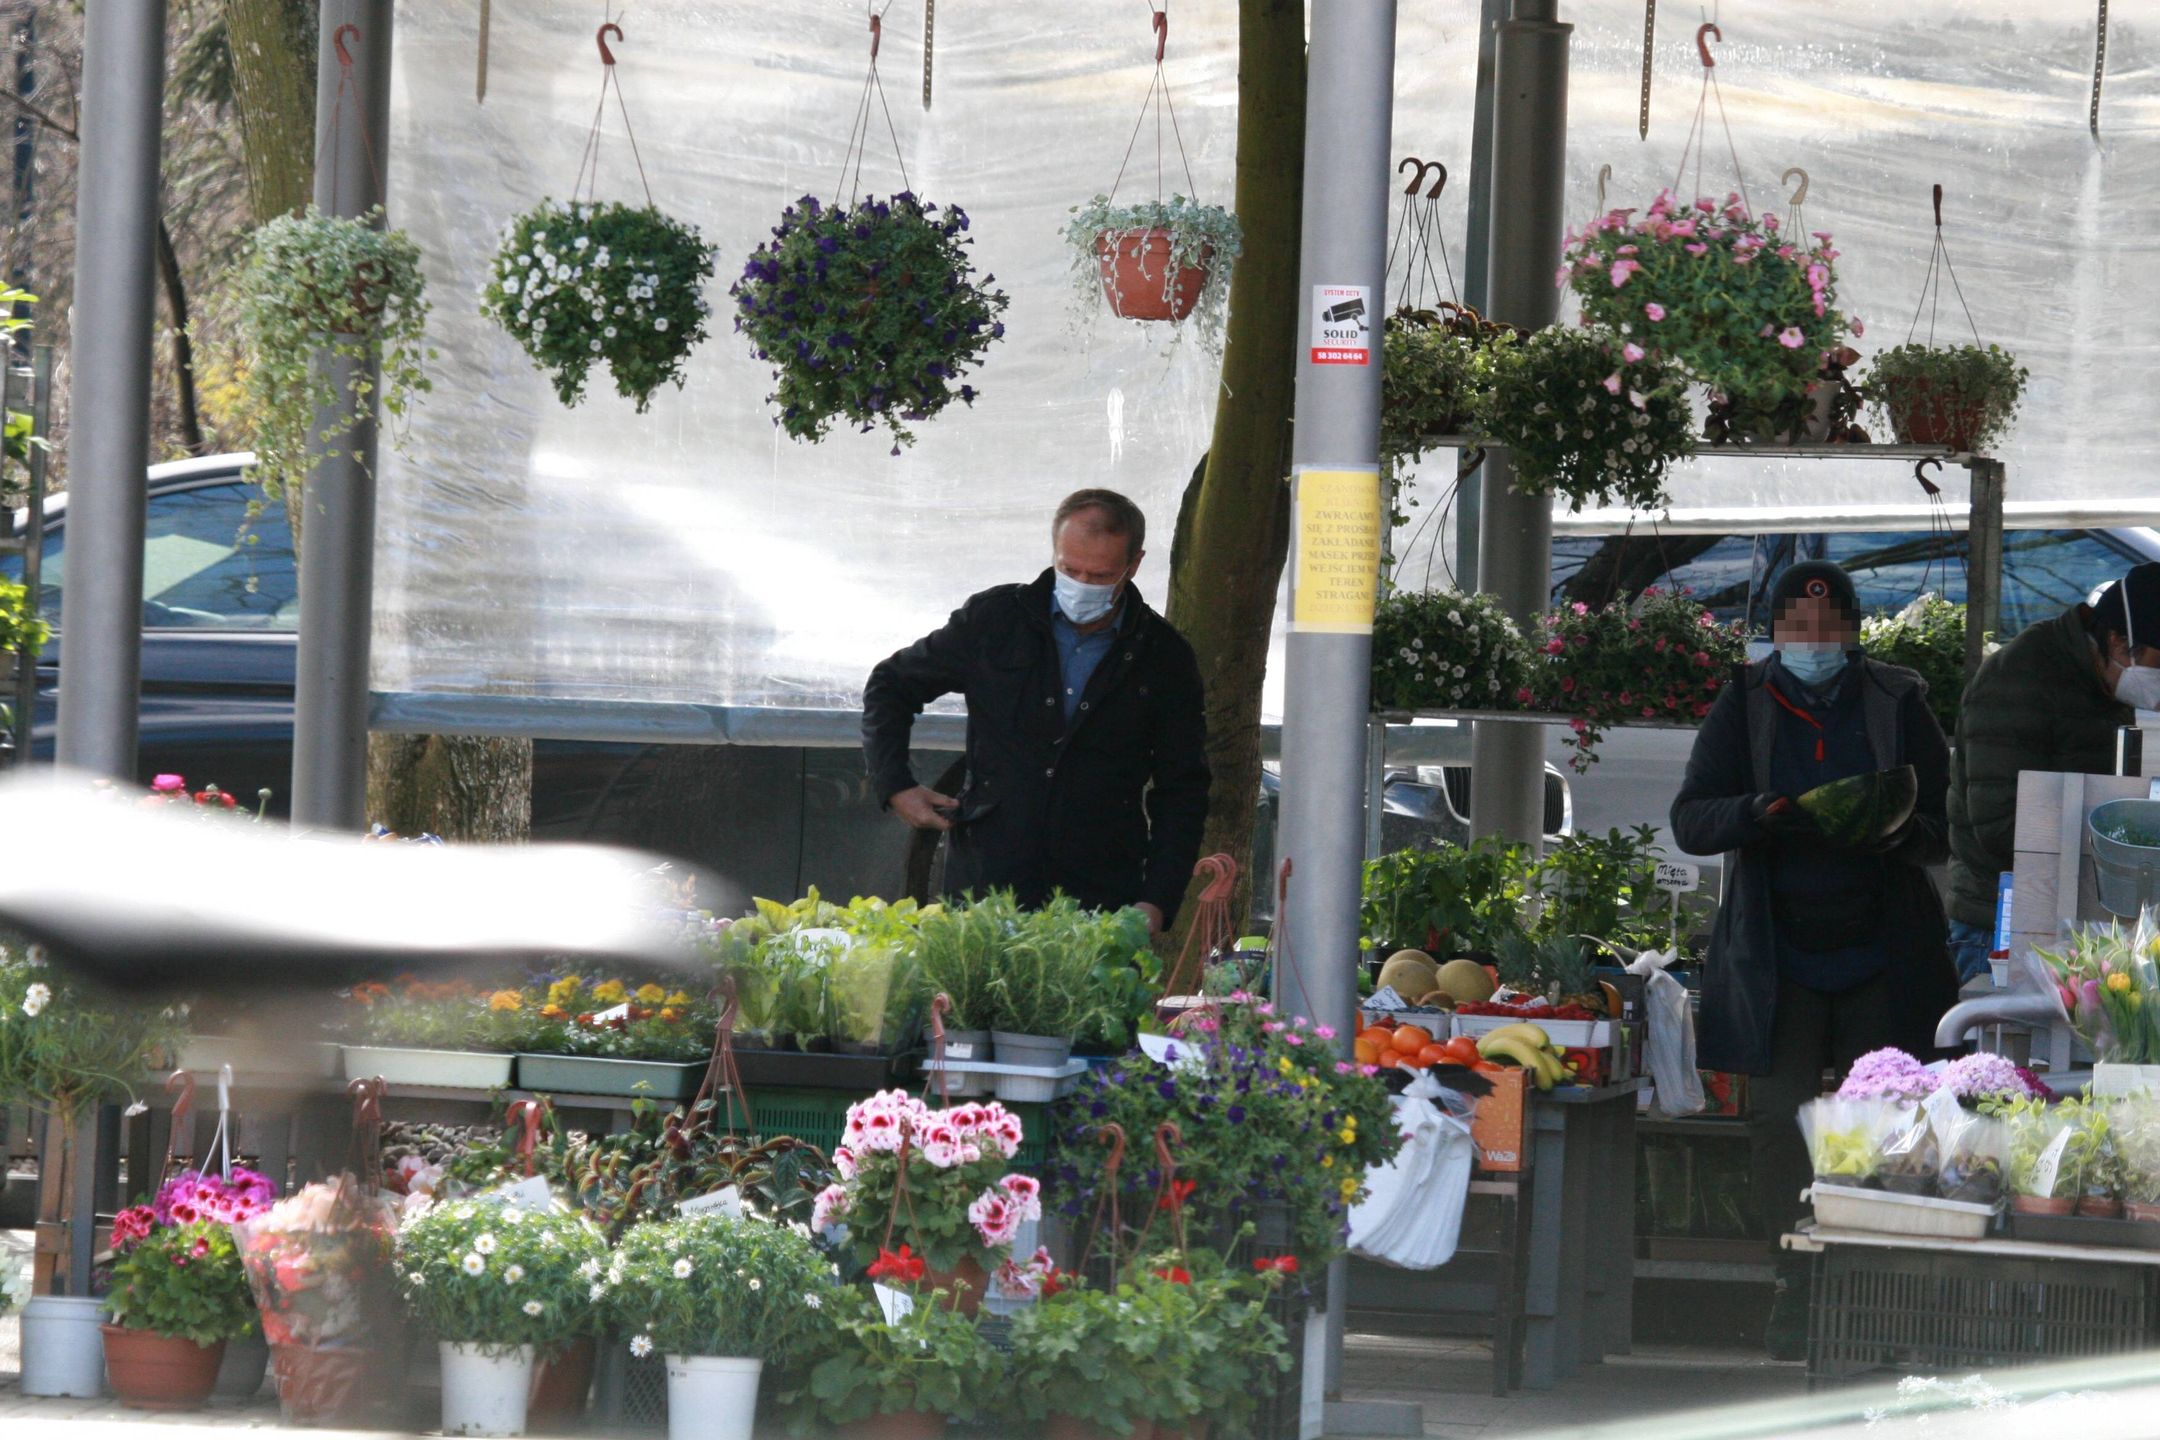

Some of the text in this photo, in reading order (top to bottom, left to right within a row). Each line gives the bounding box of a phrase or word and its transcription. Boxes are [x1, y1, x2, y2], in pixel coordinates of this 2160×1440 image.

[1323, 329, 1358, 339] SOLID
[1326, 524, 1334, 534] Z
[1308, 551, 1349, 560] MASEK
[1329, 577, 1365, 587] TEREN
